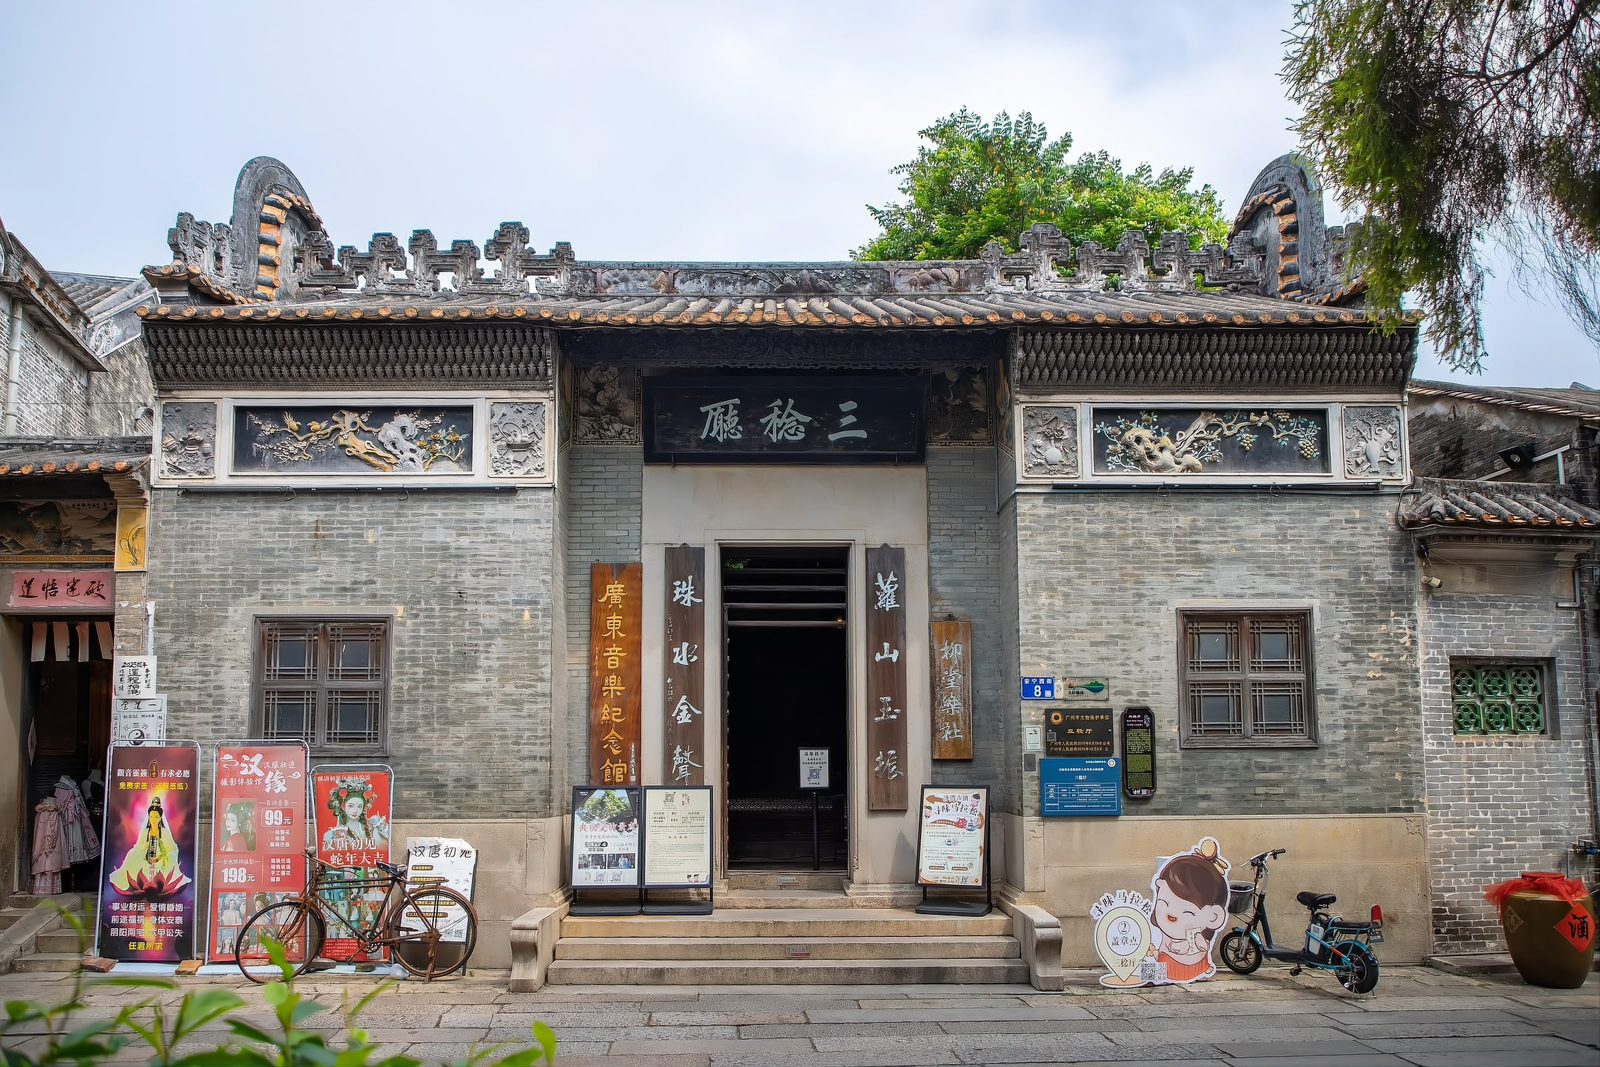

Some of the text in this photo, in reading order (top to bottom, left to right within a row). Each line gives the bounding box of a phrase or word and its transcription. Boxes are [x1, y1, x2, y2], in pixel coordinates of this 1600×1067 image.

[599, 580, 628, 784] 廣東音樂紀念館
[671, 575, 703, 786] 珠水金聲
[940, 639, 964, 741] 柳堂樂社
[1034, 685, 1041, 697] 8
[264, 810, 291, 826] 99元
[322, 838, 377, 851] 汉唐初见
[221, 867, 256, 883] 198元
[111, 903, 184, 912] 事业财运 爱情婚姻
[1095, 891, 1152, 917] 寻味马拉松
[1568, 913, 1589, 941] 酒
[128, 942, 163, 951] 任君所求
